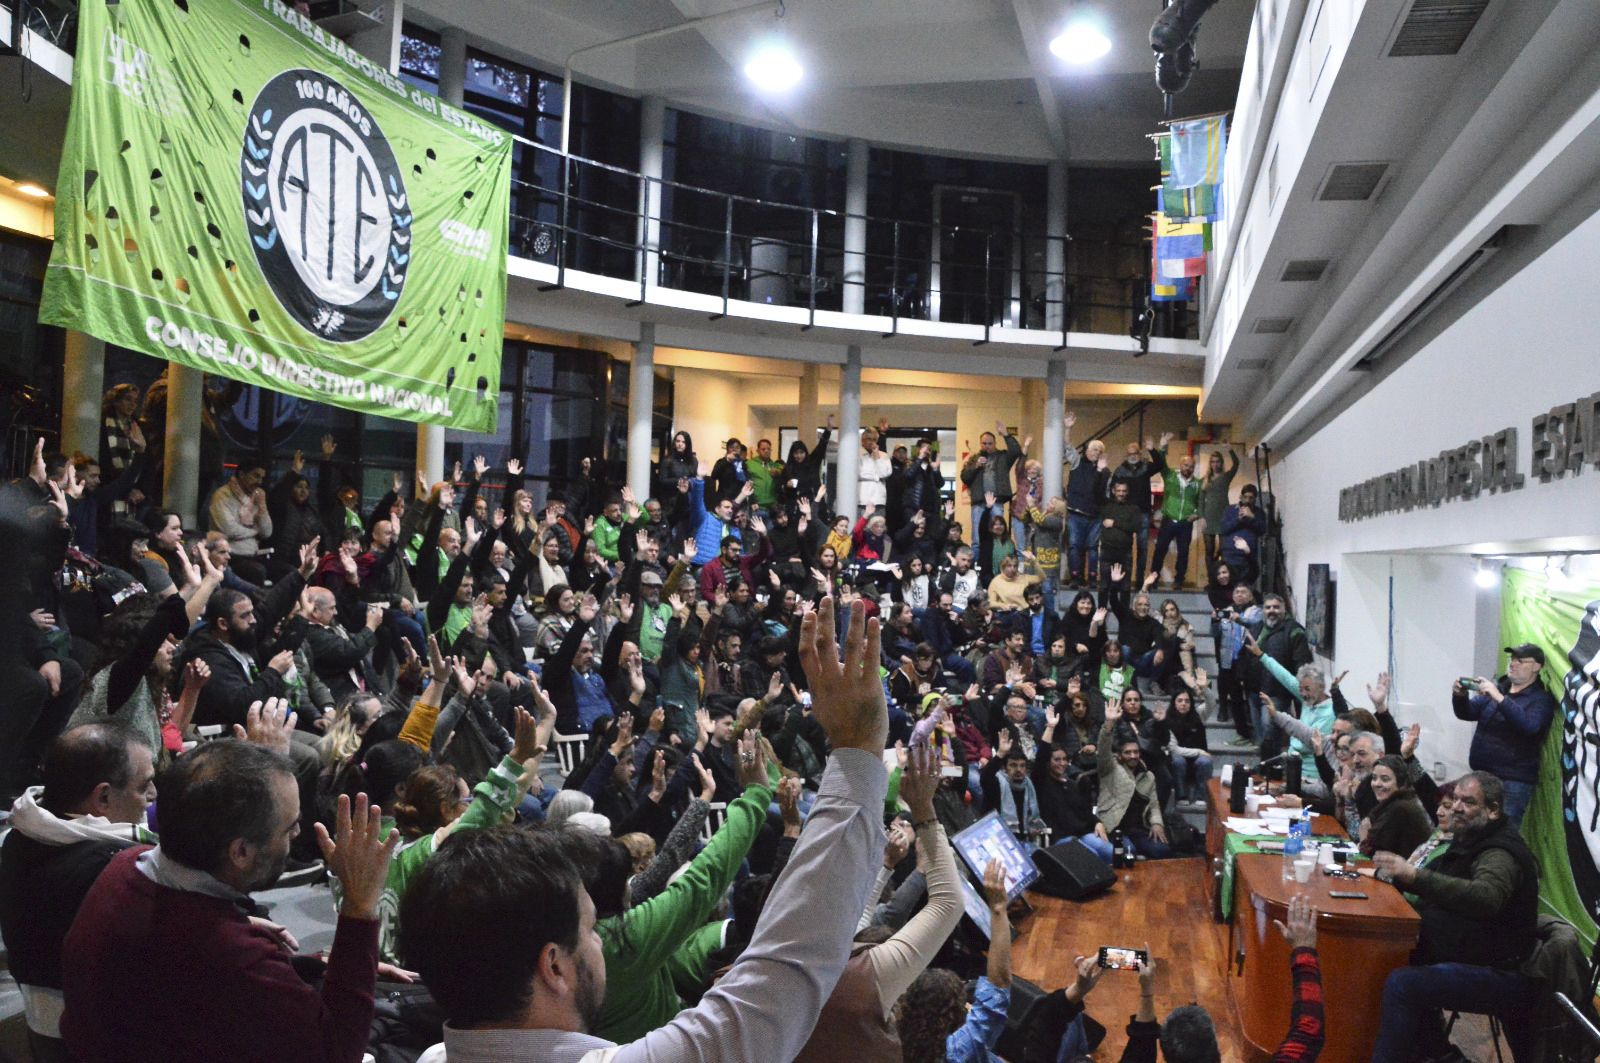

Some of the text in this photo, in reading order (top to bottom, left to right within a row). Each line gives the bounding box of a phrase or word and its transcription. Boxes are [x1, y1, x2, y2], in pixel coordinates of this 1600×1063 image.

[295, 80, 372, 137] 100 AÑOS
[411, 90, 438, 116] del
[278, 123, 378, 284] ATE
[145, 316, 453, 417] CONSEJO DIRECTIVO NACIONAL
